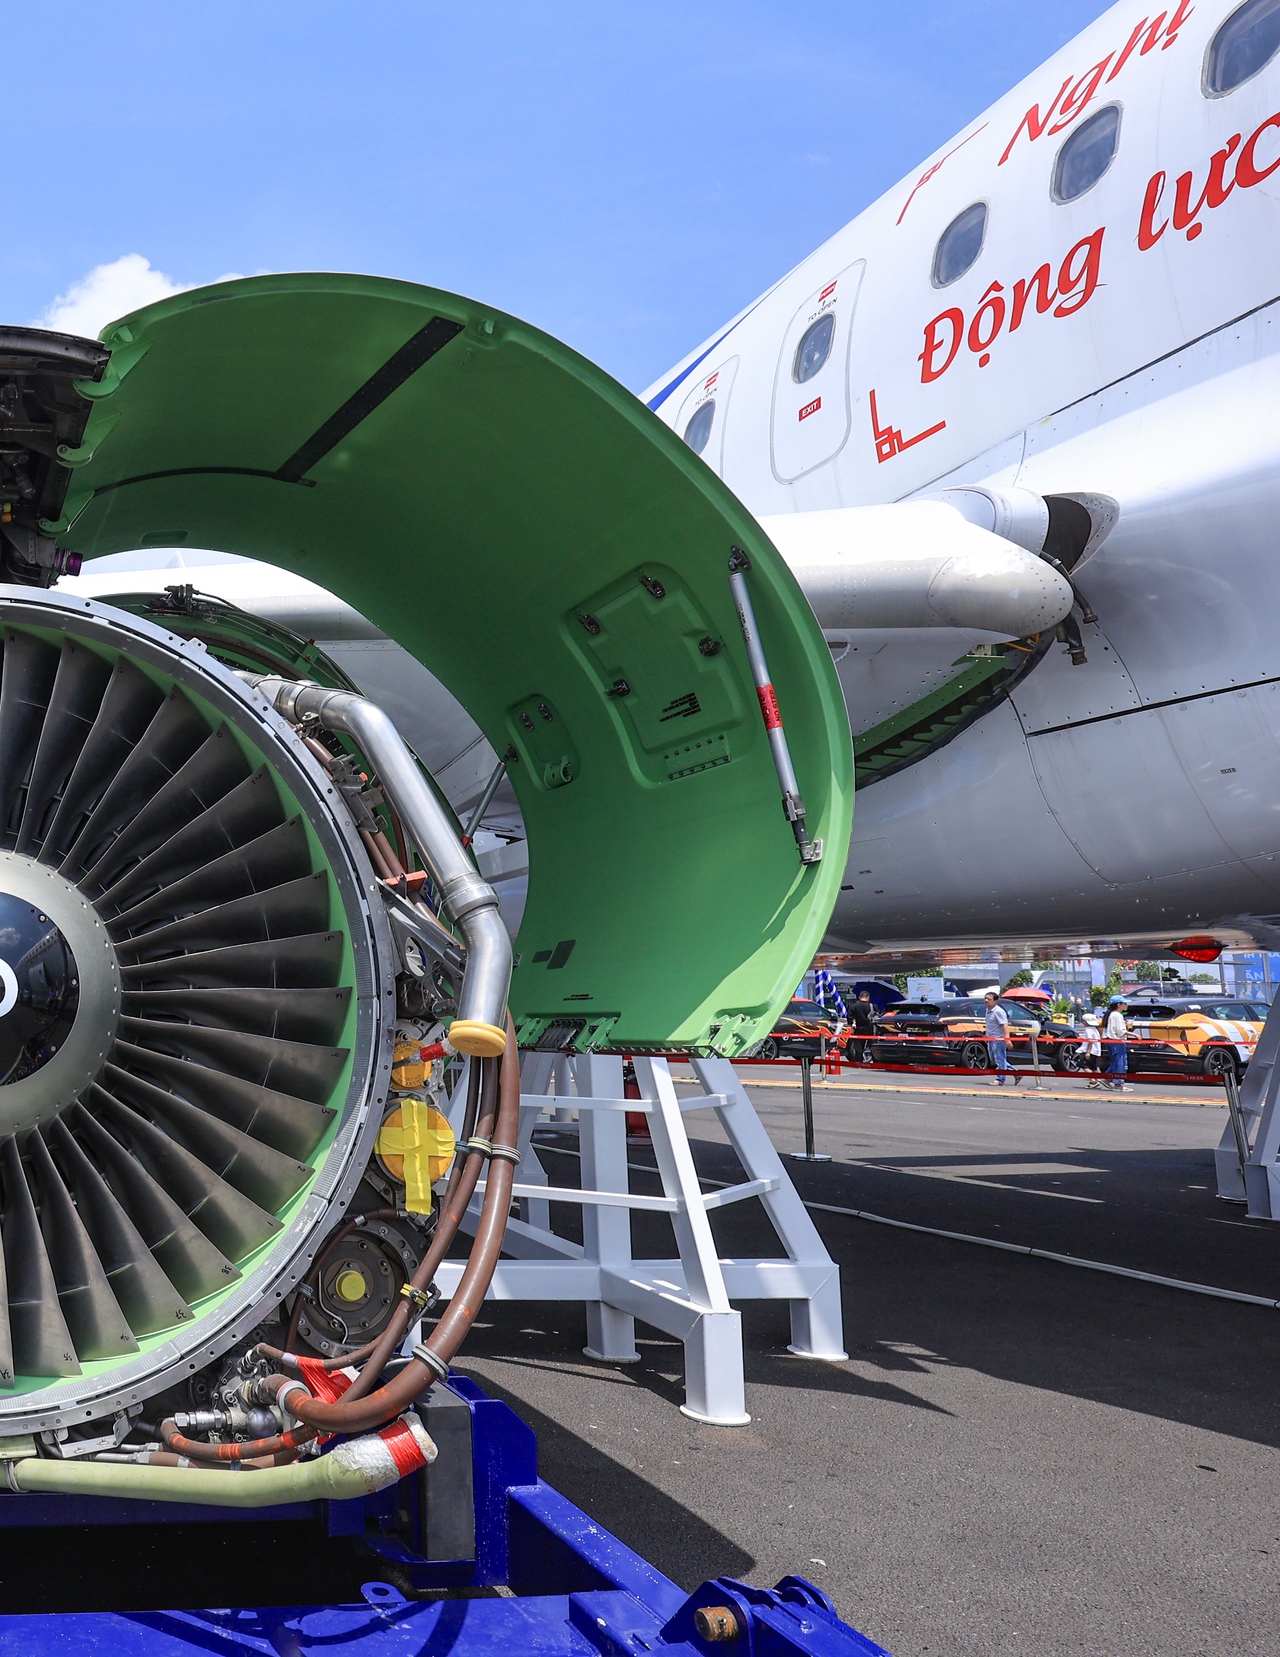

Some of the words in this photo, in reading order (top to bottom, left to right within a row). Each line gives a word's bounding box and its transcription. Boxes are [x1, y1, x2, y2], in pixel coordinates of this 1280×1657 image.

[917, 226, 1108, 384] Động
[802, 402, 819, 417] EXIT
[769, 690, 778, 709] STEP
[774, 710, 781, 722] NO
[221, 1265, 232, 1274] 38
[175, 1309, 187, 1320] 37
